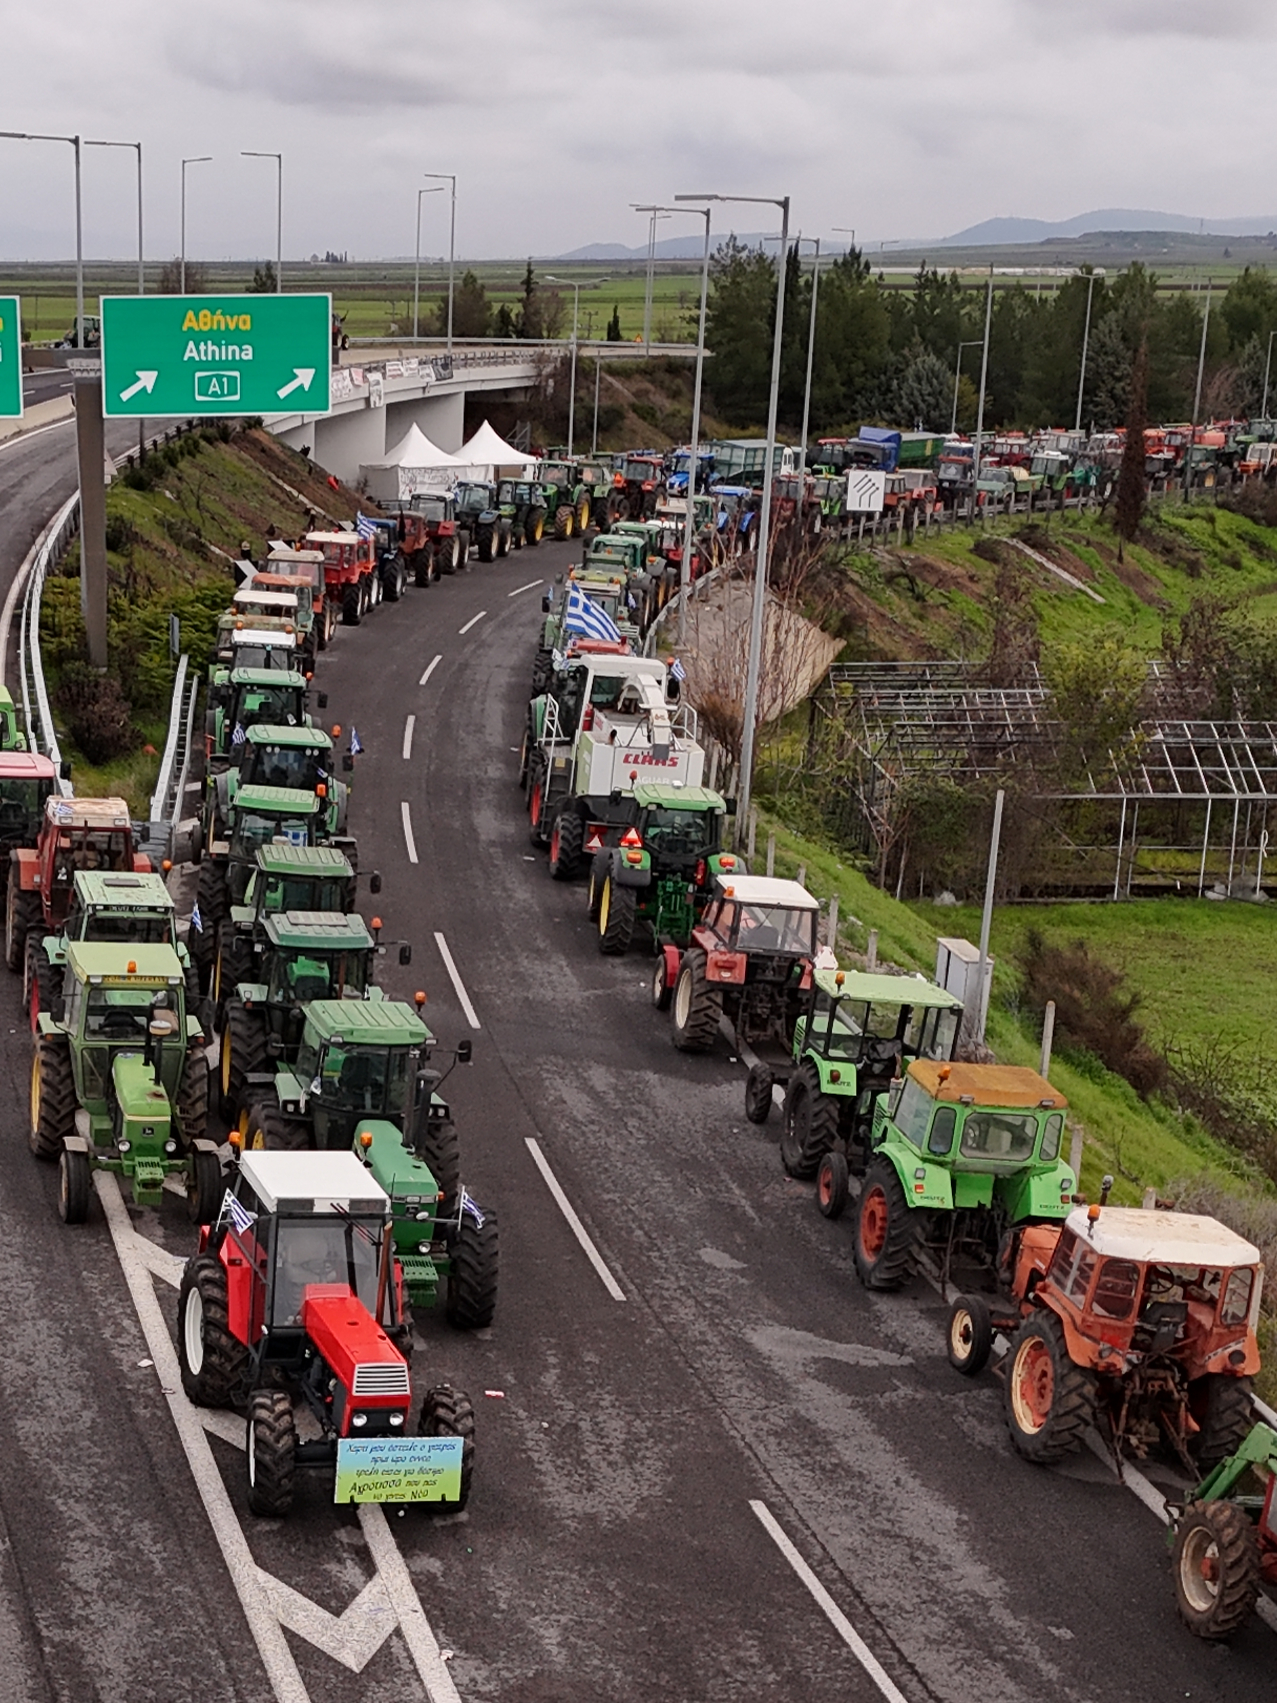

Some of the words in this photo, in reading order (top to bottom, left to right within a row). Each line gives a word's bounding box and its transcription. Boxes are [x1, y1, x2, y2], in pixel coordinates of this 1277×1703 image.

[182, 309, 251, 331] Αθήνα
[183, 340, 253, 361] Athina
[208, 377, 228, 395] A1
[623, 753, 679, 767] CLAAS
[634, 775, 670, 785] AGUAR
